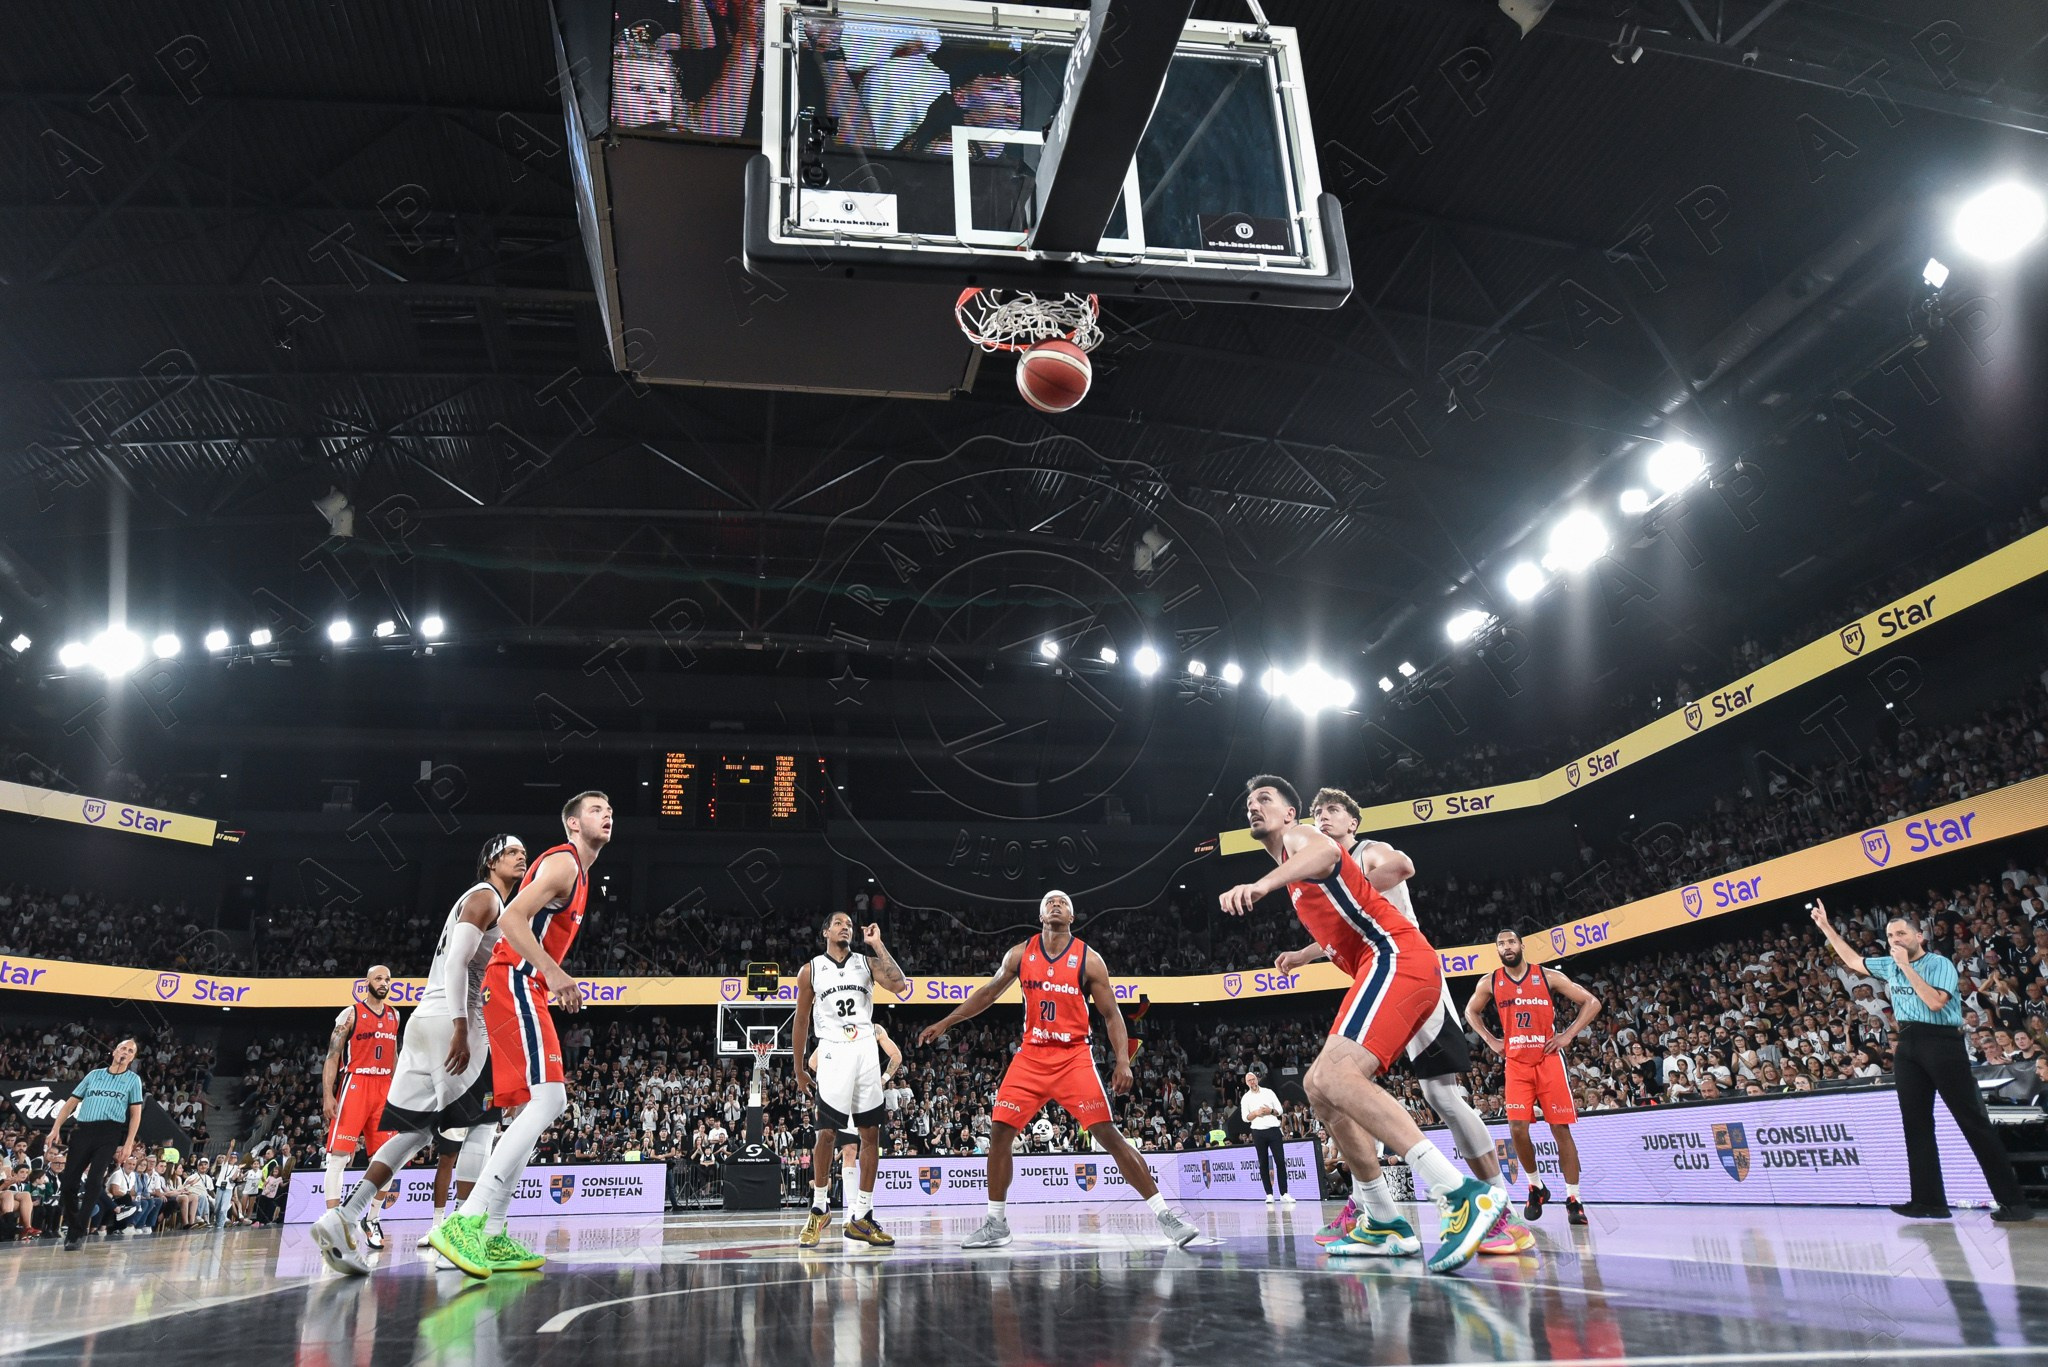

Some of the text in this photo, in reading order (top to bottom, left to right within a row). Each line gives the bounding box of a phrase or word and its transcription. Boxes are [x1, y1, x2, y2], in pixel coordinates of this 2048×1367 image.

[1845, 595, 1937, 646] BT Star
[1686, 683, 1755, 720] BT Star
[1568, 749, 1620, 778] BT Star
[1417, 794, 1495, 815] BT Star
[87, 804, 172, 833] BT Star
[1867, 811, 1976, 853] BT Star
[1686, 876, 1762, 908] BT Star
[1553, 921, 1611, 948] BT Star
[0, 960, 46, 986] tar
[1441, 953, 1479, 973] tar
[161, 978, 250, 1002] BT Star
[388, 981, 426, 1002] Sta
[578, 981, 628, 1001] Star
[725, 984, 737, 992] BT
[927, 981, 974, 999] Star
[1110, 984, 1138, 999] ar
[1227, 973, 1300, 992] BT Star
[836, 997, 857, 1018] 32
[1039, 1000, 1056, 1022] 20
[1515, 1012, 1532, 1029] 22
[1508, 1034, 1546, 1046] PROLINE
[375, 1044, 383, 1060] 0
[355, 1066, 392, 1076] PROLIN
[86, 1089, 126, 1101] LINKSOFT
[1756, 1123, 1854, 1145] CONSILIUL
[1674, 1153, 1710, 1170] CLUJ
[1760, 1147, 1860, 1173] JUDEȚEAN
[582, 1176, 644, 1187] CONSILIUL
[876, 1170, 912, 1182] DEȚUL
[948, 1168, 987, 1179] CONSIL
[1042, 1177, 1069, 1187] CLUJ
[512, 1190, 542, 1200] CLUJ
[885, 1180, 912, 1191] CLUJ
